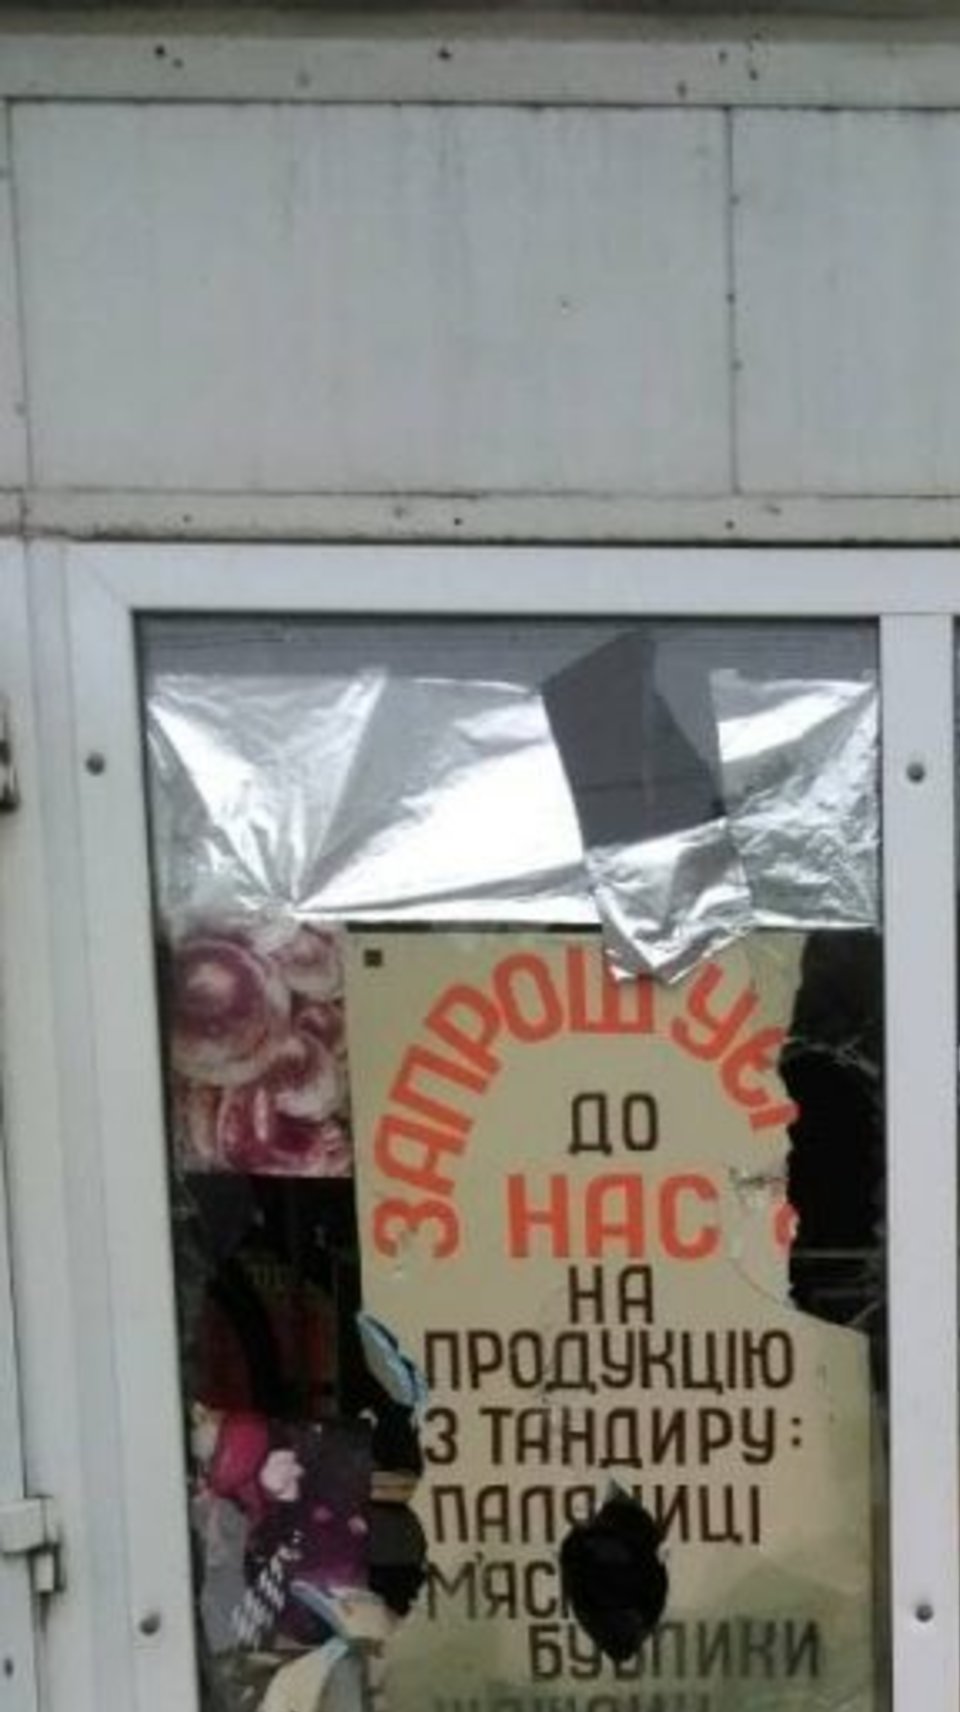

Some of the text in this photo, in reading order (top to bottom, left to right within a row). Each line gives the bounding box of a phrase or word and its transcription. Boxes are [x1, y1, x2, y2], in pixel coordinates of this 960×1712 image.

[568, 1091, 660, 1156] ДО
[506, 1172, 721, 1262] НАС
[568, 1264, 656, 1325] НА
[423, 1329, 796, 1395] ПРОДУКЦІЮ
[424, 1406, 802, 1469] З ТАНДИРУ:
[431, 1484, 761, 1546] ПАЛЯИЦІ
